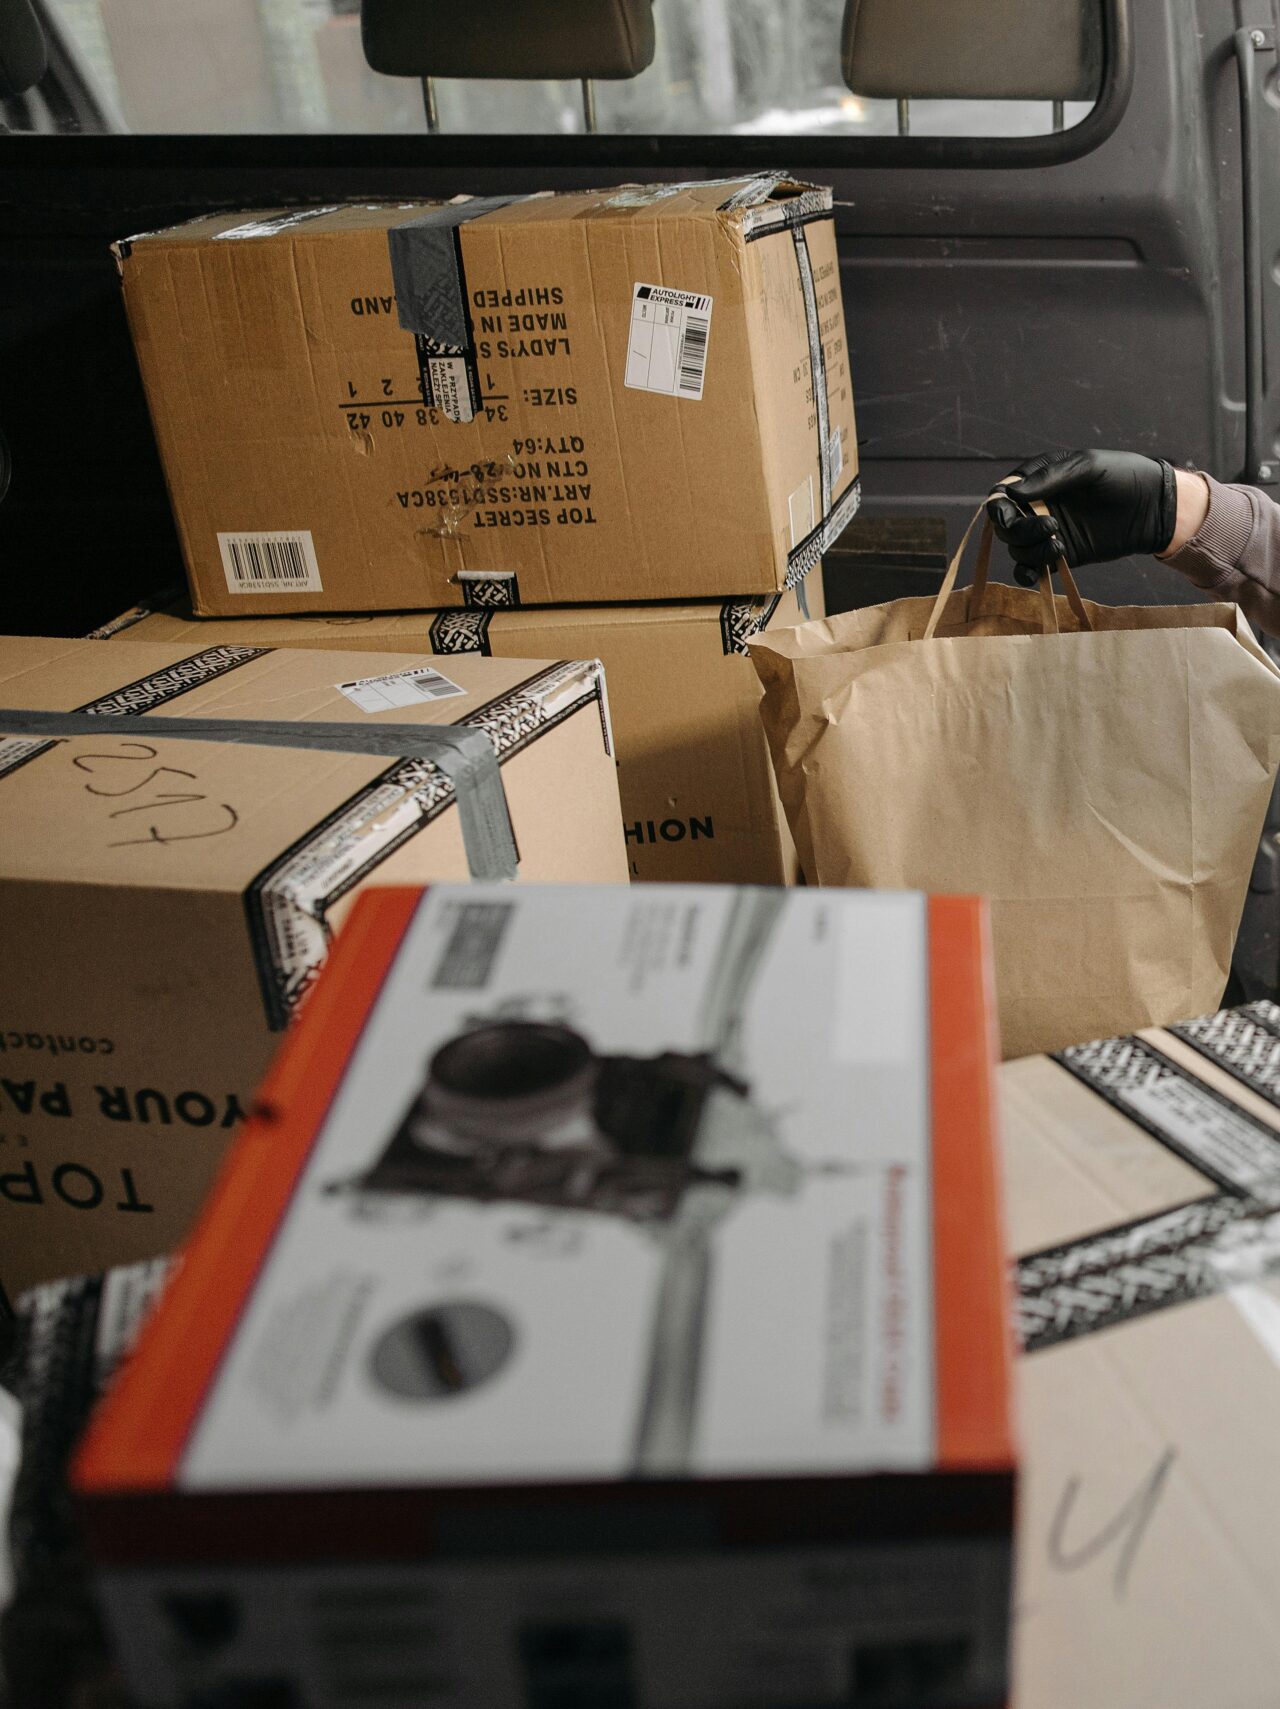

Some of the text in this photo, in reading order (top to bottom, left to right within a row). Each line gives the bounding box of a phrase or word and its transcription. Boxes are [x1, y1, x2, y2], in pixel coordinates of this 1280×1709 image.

[351, 287, 563, 316] SHIPPED AND
[650, 295, 684, 306] EXPRESS
[652, 288, 697, 302] AUTOLIGHT
[481, 312, 567, 333] MADE IN
[476, 337, 571, 359] LADY'S S
[447, 361, 454, 370] W
[347, 374, 496, 398] 1 2 1
[438, 361, 452, 414] ZAKLEJENIA
[523, 388, 578, 406] SIZE:
[347, 404, 509, 430] 34 38 40 42
[512, 435, 585, 455] QTY:64
[547, 460, 588, 478] CTN
[474, 508, 597, 528] TOP SECRET
[0, 1077, 250, 1129] YOUR PA
[0, 1160, 154, 1214] TOP
